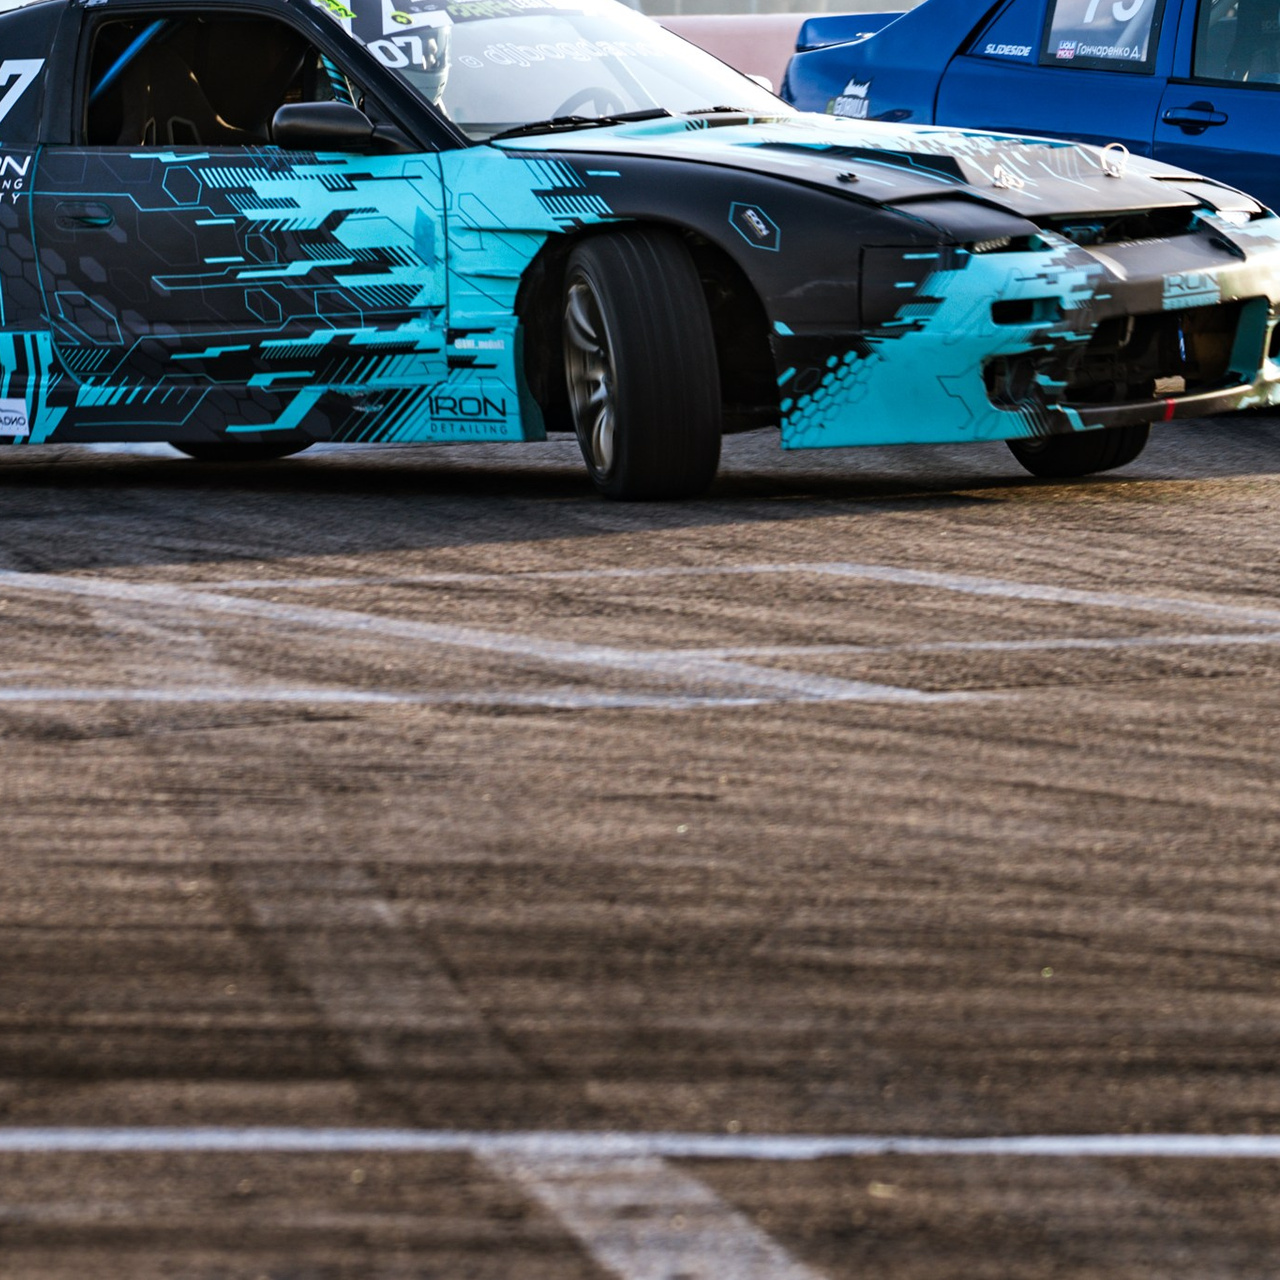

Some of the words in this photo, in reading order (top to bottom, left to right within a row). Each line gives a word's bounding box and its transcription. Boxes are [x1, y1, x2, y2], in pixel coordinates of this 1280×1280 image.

[366, 35, 425, 69] 07
[985, 43, 1032, 57] SLIDESIDE
[1076, 42, 1130, 58] Гончаренко
[427, 395, 508, 418] IRON
[430, 422, 509, 436] DETAILING
